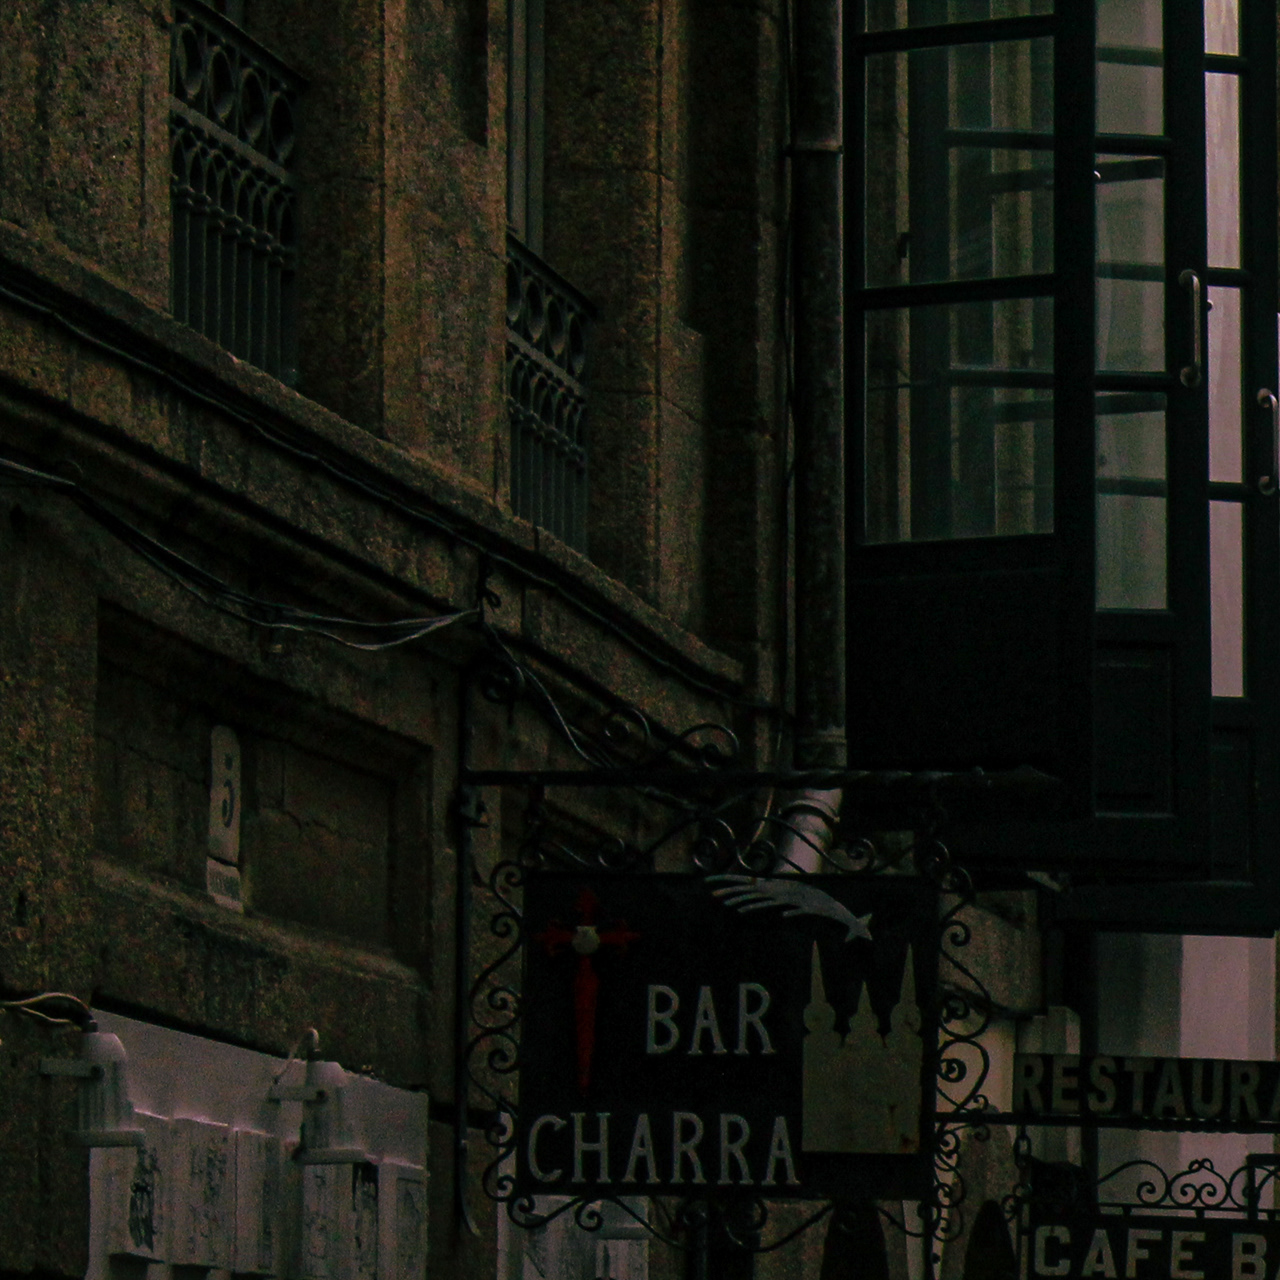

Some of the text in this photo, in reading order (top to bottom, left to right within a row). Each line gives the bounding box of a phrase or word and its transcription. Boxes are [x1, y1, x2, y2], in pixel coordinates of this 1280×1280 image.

[645, 982, 776, 1057] BAR
[528, 1112, 800, 1187] CHARRA
[1033, 1224, 1206, 1280] CAFE
